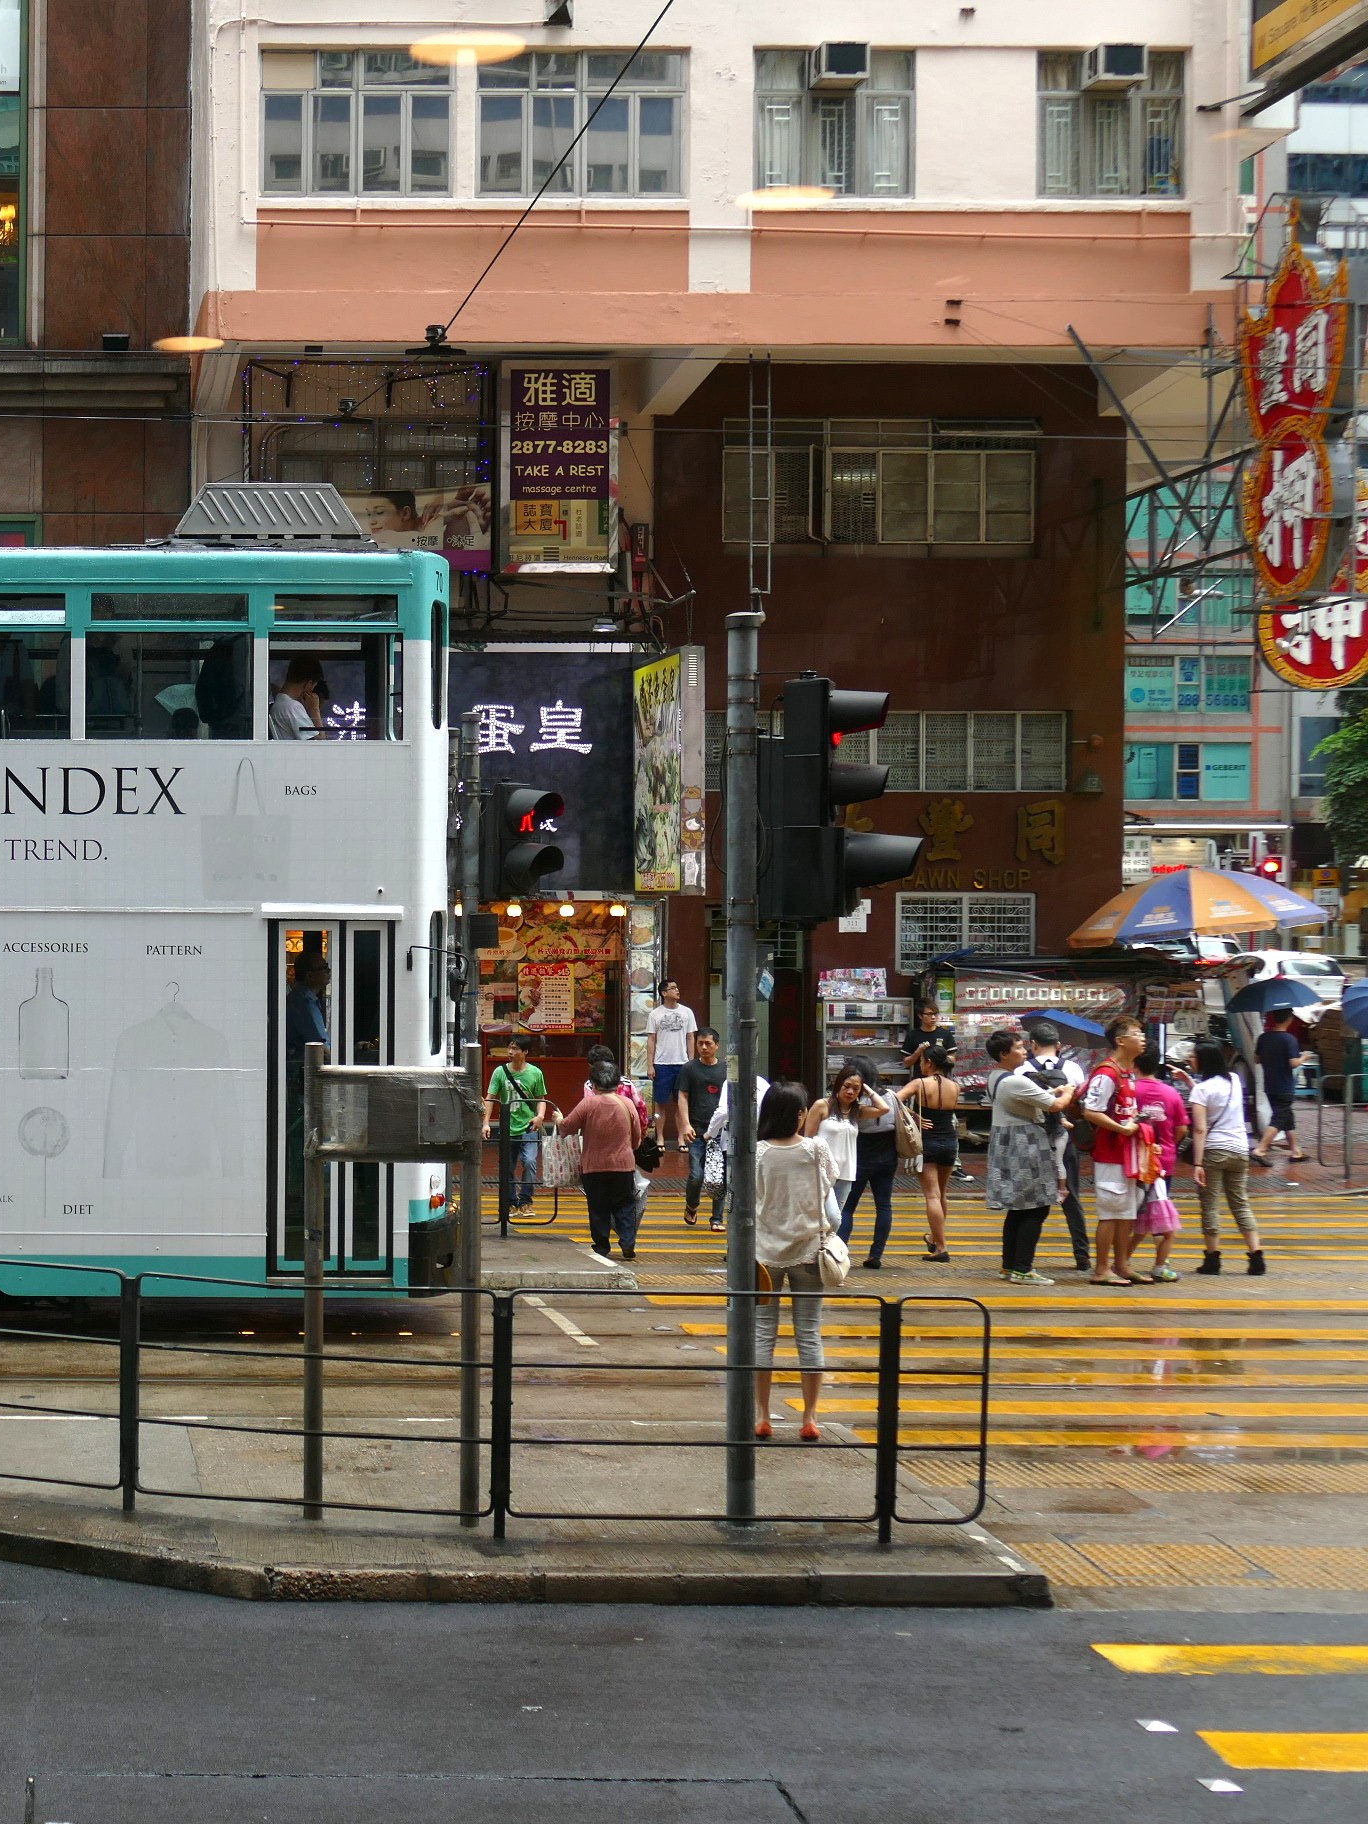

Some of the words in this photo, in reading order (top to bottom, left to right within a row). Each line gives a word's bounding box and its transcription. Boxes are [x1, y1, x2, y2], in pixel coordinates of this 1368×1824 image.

[522, 371, 597, 406] 雅適
[515, 411, 605, 431] 按摩中心
[511, 440, 608, 454] 2877-8283
[514, 464, 550, 477] TAKE
[554, 465, 565, 476] A
[569, 464, 605, 477] REST
[522, 486, 562, 496] massage
[564, 484, 597, 494] centre
[416, 534, 439, 547] 按摩
[451, 534, 475, 547] 沐足
[563, 554, 593, 563] Hennessy
[285, 785, 317, 796] BAGS
[3, 839, 108, 861] TREND.
[973, 868, 1032, 889] SHOP
[3, 942, 89, 953] ACCESSORIES
[146, 945, 202, 956] PATTERN
[63, 1204, 94, 1215] DIET
